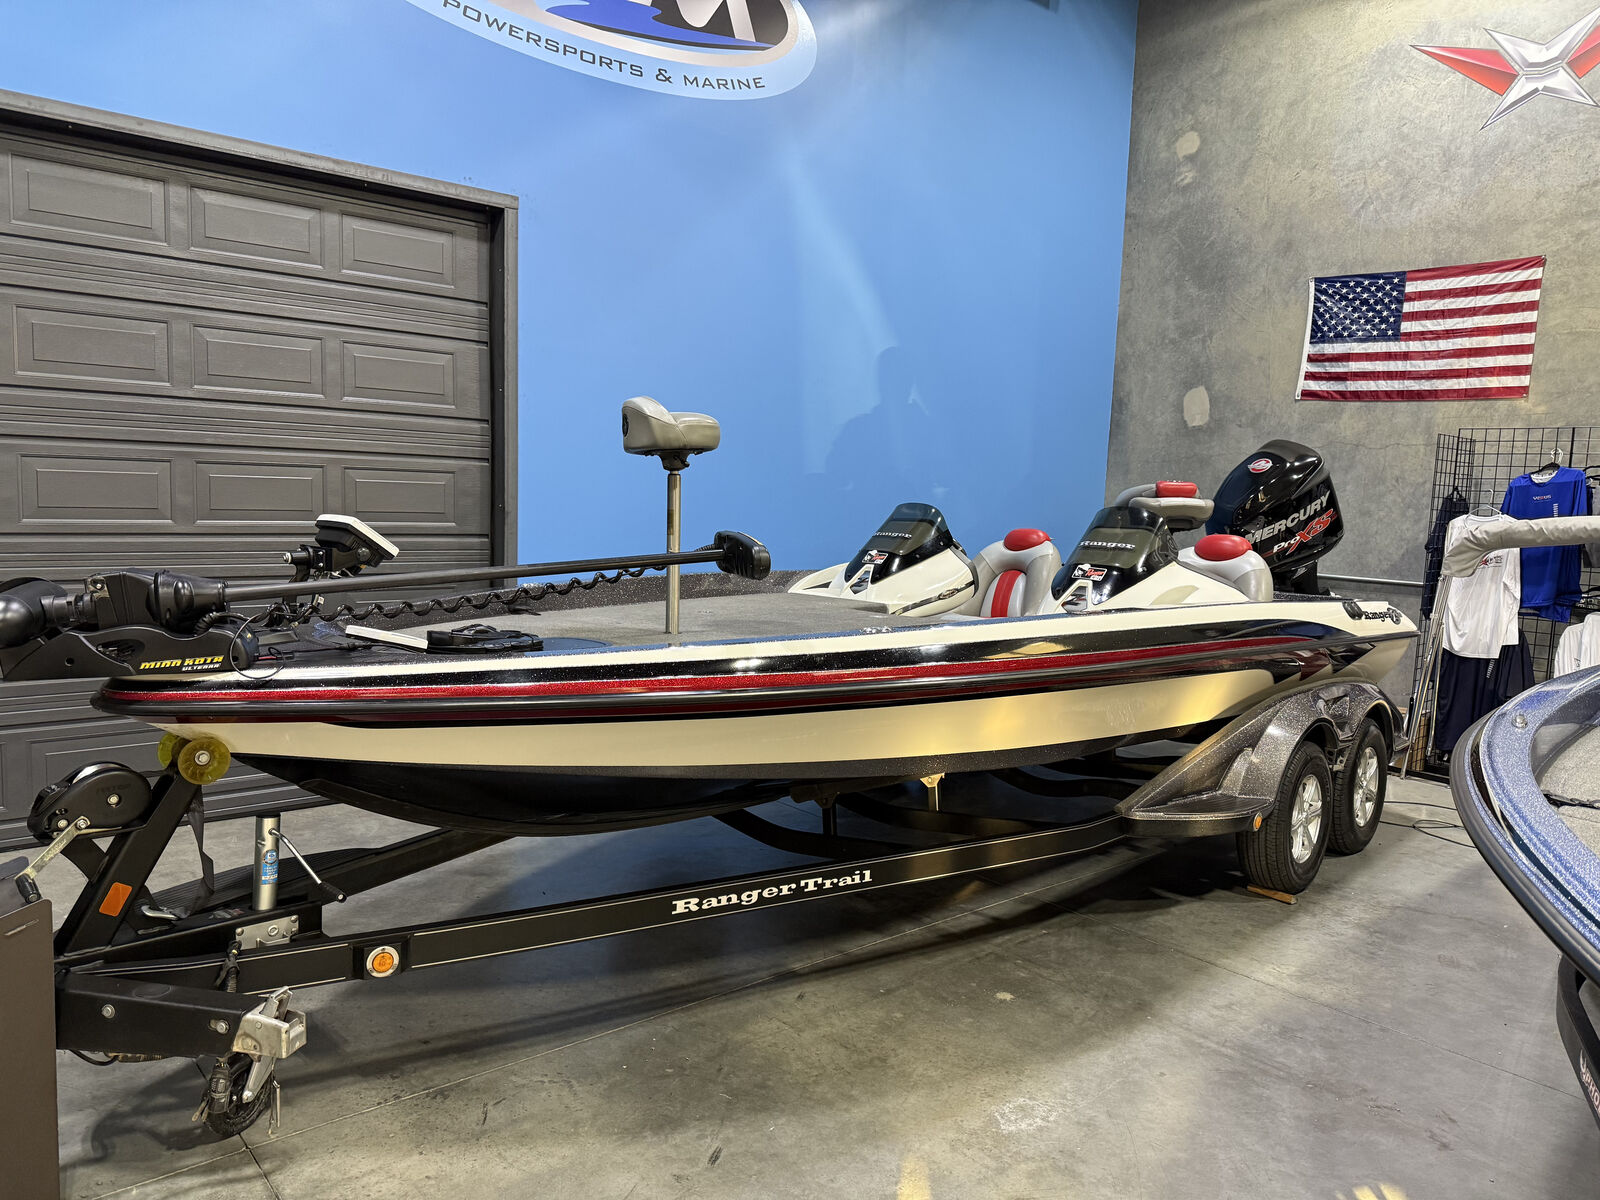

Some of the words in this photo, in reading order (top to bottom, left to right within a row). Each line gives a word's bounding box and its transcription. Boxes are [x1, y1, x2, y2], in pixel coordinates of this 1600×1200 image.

[443, 0, 644, 78] POWERSPORTS
[655, 68, 673, 84] &
[683, 74, 766, 91] MARINE
[1244, 490, 1331, 544] MERCURY
[1080, 540, 1136, 549] Ranger
[184, 655, 225, 666] KOTA
[671, 883, 797, 915] Ranger
[800, 869, 873, 892] Trail
